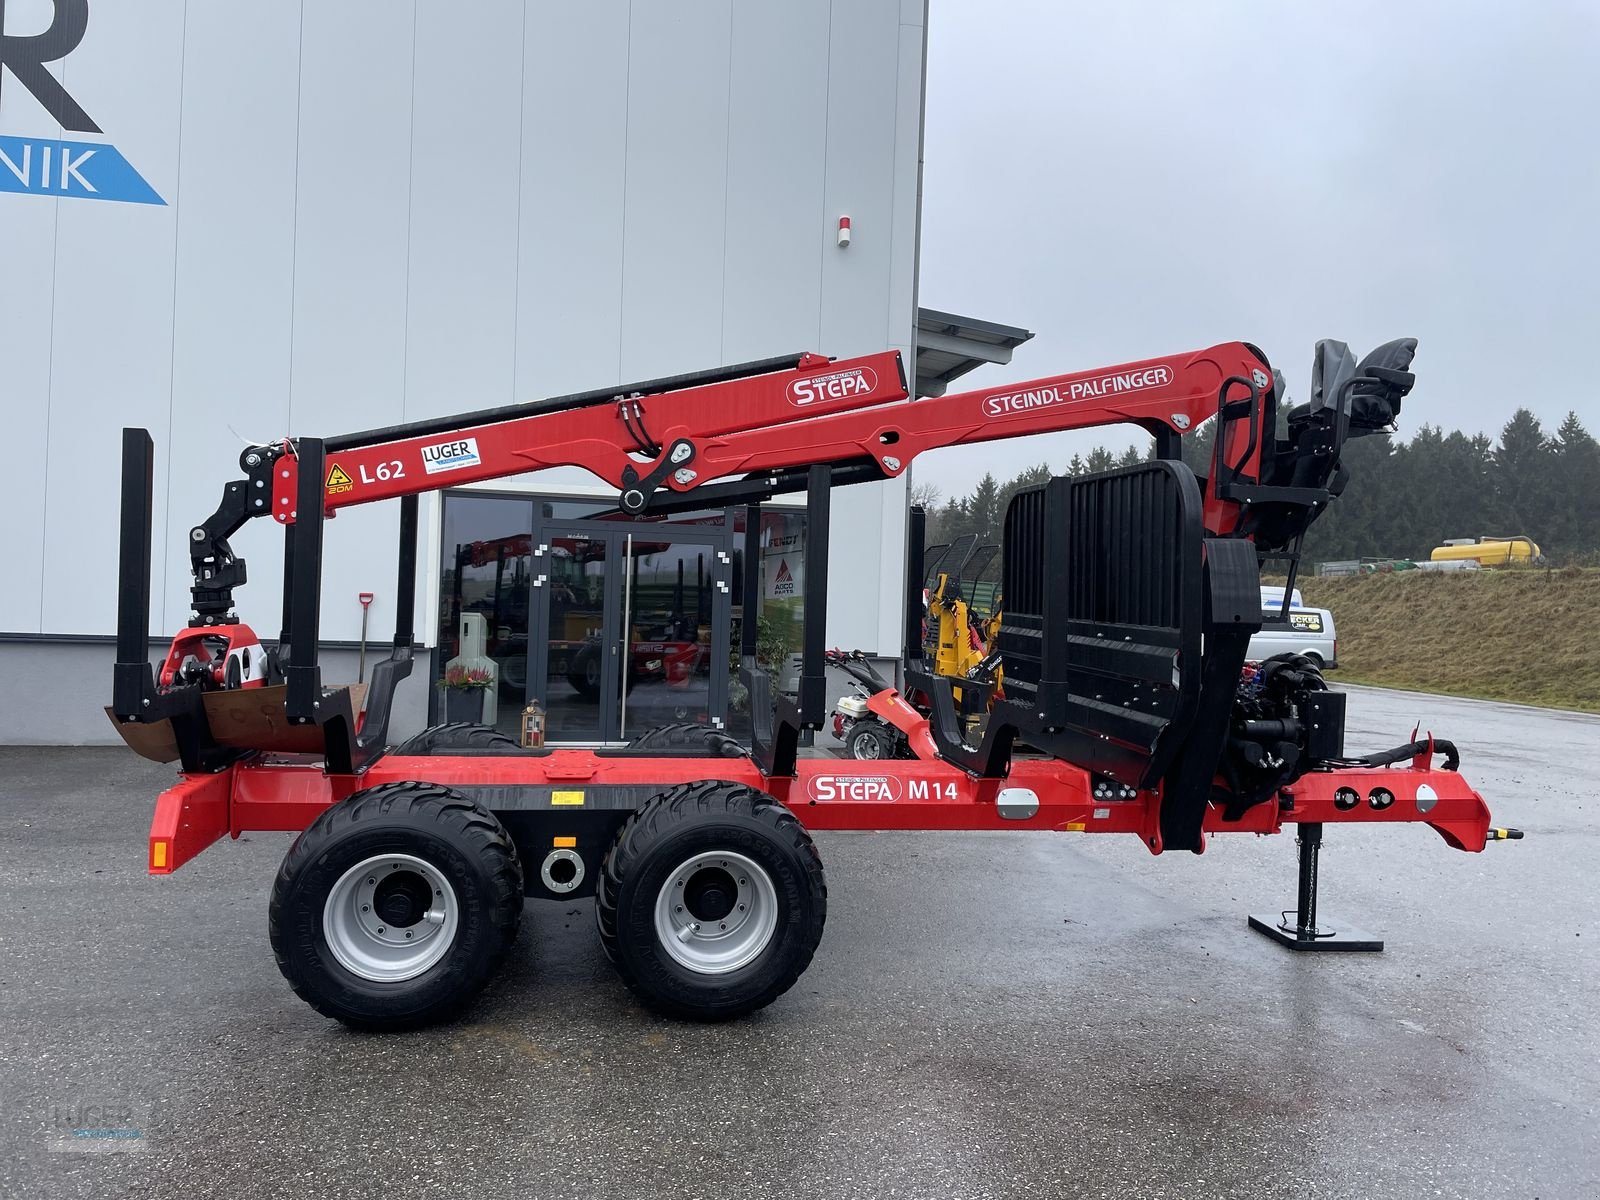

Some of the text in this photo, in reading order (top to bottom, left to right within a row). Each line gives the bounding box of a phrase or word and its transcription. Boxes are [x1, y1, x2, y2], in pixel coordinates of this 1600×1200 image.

[793, 375, 871, 404] STEPA
[988, 368, 1168, 414] STEINDL-PALFINGER
[423, 441, 471, 462] LUGER
[359, 460, 406, 484] L62
[328, 484, 354, 495] 20M
[769, 534, 799, 547] FENDT
[816, 777, 894, 801] STEPA
